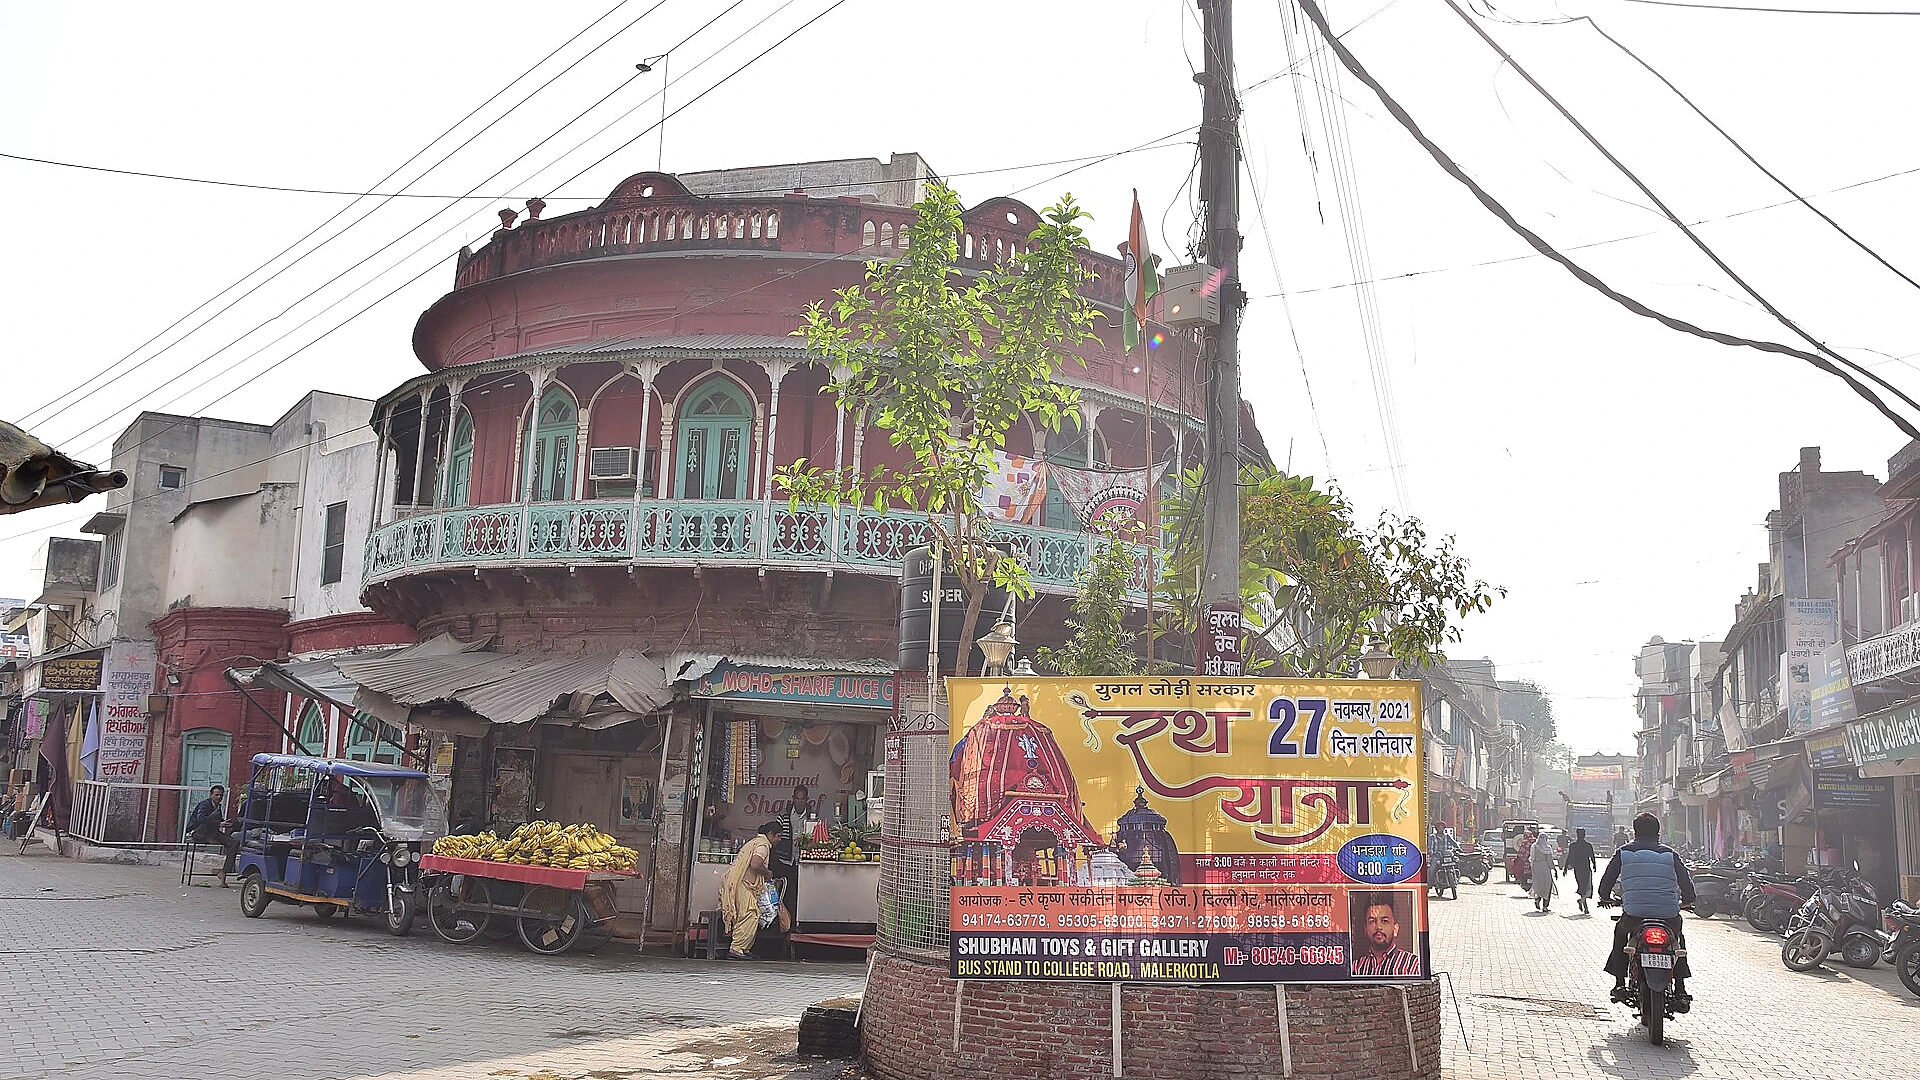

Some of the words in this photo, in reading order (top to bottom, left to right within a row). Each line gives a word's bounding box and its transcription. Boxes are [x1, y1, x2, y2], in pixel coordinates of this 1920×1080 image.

[721, 671, 777, 693] MOHD.
[780, 674, 834, 697] SHARIF
[837, 677, 879, 699] JUICE
[882, 679, 894, 700] C
[1095, 683, 1144, 701] युगल
[1149, 679, 1191, 699] जोड़ी
[1196, 684, 1256, 697] सरकार
[1269, 698, 1327, 755] 27
[1333, 702, 1376, 724] नवम्बर,
[1379, 702, 1410, 719] 2021
[1879, 708, 1920, 751] Collecti
[1331, 730, 1357, 754] दिन
[1362, 730, 1413, 754] शनिवार
[757, 773, 819, 789] hammad
[743, 793, 827, 816] Shaef
[1215, 779, 1385, 846] यात्रा
[1214, 856, 1232, 868] 3:00
[1234, 857, 1246, 867] बजे
[1259, 856, 1278, 867] काली
[1280, 857, 1297, 867] माता
[1357, 862, 1382, 876] 8:00
[1386, 862, 1404, 875] बजे
[958, 892, 1002, 907] आयोजक
[1019, 889, 1035, 907] हरे
[1038, 892, 1065, 911] कृष्ण
[1069, 888, 1115, 907] संकीर्तन
[1158, 889, 1198, 911] (रजि.)
[1202, 889, 1237, 907] दिल्ली
[1265, 889, 1332, 907] मालेरकोटला
[962, 913, 1050, 929] 94174-63778,
[1057, 914, 1147, 930] 95305-68000,
[1151, 915, 1240, 930] 84371-27600,
[1247, 915, 1331, 929] 98558-51658
[957, 936, 1037, 956] SHUBHAM
[1041, 937, 1080, 956] TOYS
[1084, 938, 1097, 957] &
[1101, 938, 1136, 957] GIFT
[1139, 938, 1209, 958] GALLERY
[1252, 945, 1344, 966] 80546-66345
[957, 960, 982, 976] BUS
[984, 960, 1021, 976] STAND
[1024, 960, 1040, 976] TO
[1043, 960, 1095, 978] COLLEGE
[1097, 961, 1135, 980] ROAD,
[1140, 961, 1220, 979] MALERKOTLA
